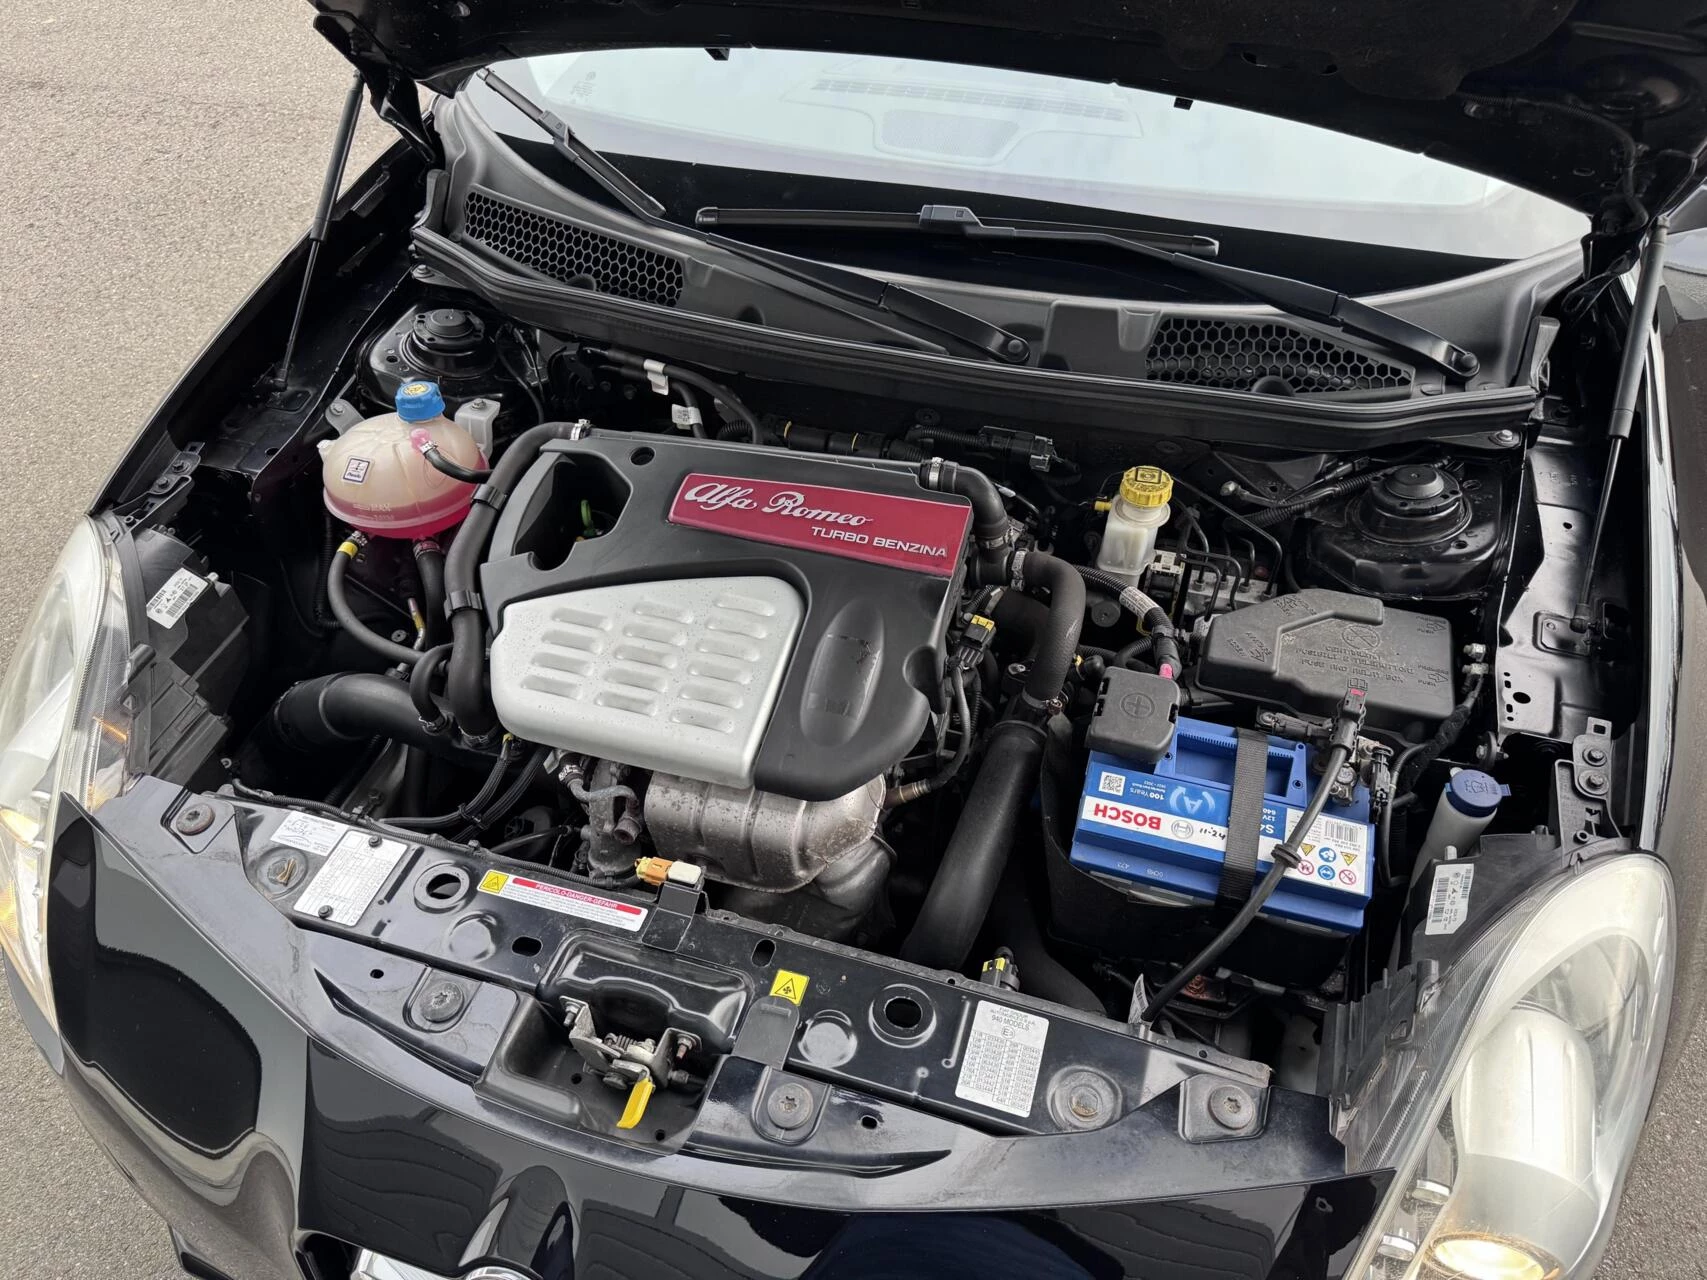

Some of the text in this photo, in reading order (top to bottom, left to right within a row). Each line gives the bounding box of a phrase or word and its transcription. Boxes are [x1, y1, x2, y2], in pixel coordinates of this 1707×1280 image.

[684, 483, 873, 526] Alfa Romeo
[811, 526, 947, 557] TURBO BENZINA
[1129, 787, 1164, 800] 100 Years
[1094, 803, 1161, 830] BOSCH
[1002, 1017, 1030, 1031] MODELS
